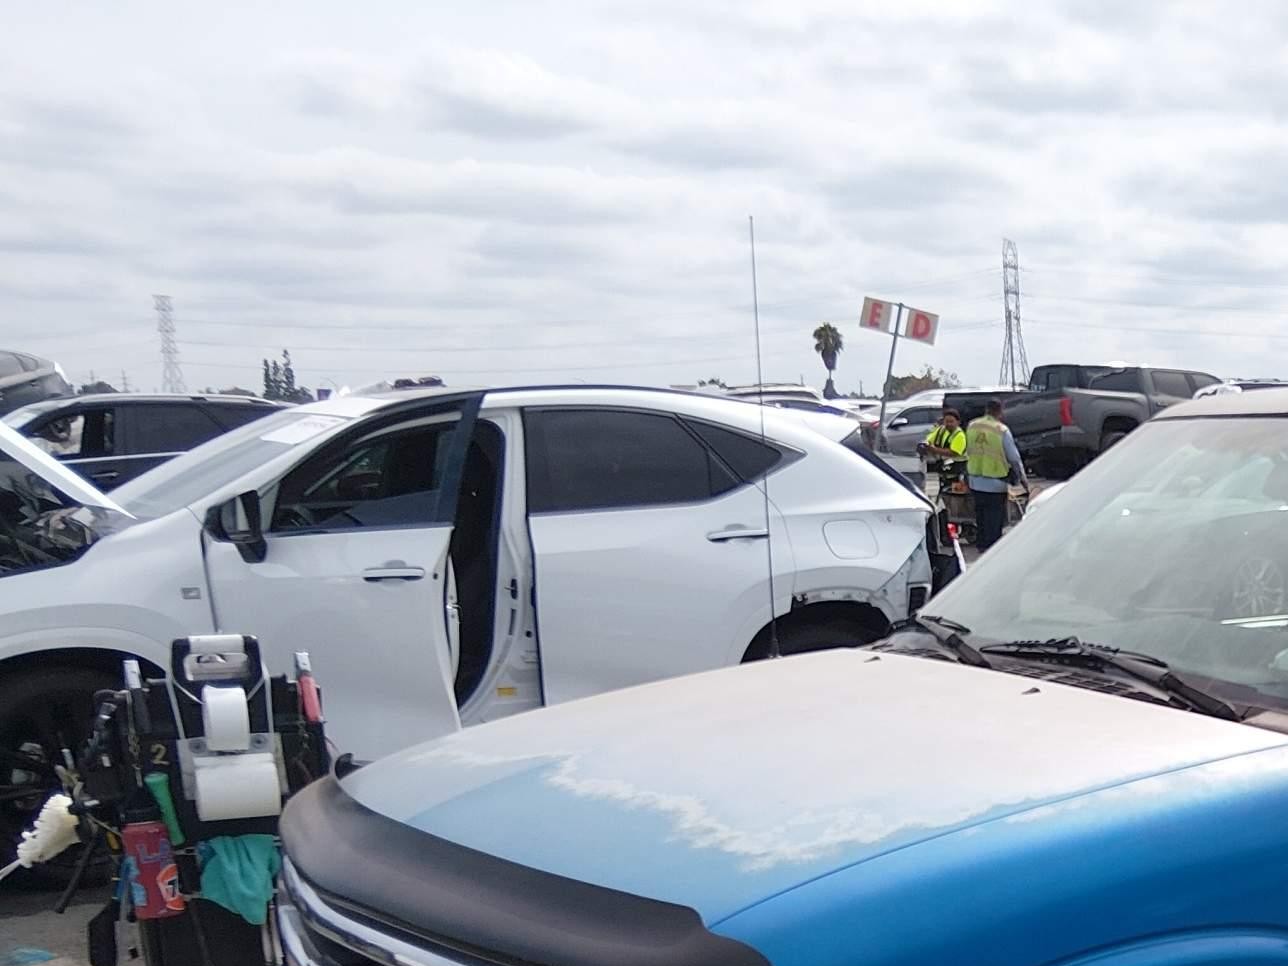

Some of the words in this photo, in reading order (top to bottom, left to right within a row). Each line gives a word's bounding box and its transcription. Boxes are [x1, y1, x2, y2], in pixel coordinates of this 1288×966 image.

[868, 302, 883, 328] E
[912, 312, 932, 340] D
[150, 743, 171, 766] 2
